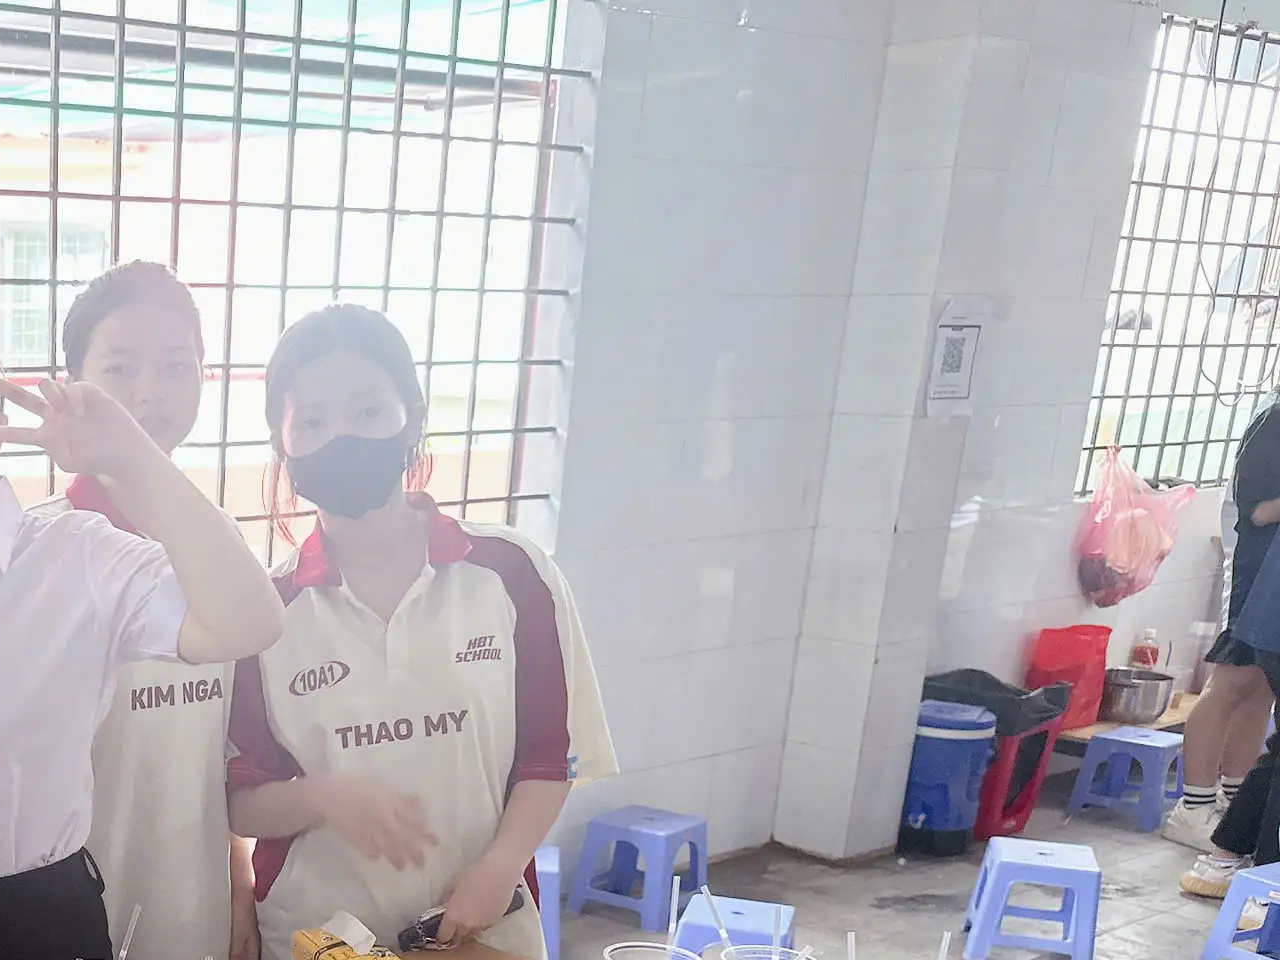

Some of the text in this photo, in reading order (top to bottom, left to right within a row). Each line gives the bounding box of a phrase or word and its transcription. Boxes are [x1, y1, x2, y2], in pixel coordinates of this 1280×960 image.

[455, 648, 502, 663] SCHOOL
[467, 635, 495, 650] HBT
[299, 664, 335, 692] 10A1
[131, 678, 223, 711] KIM NGA
[335, 710, 468, 749] THAO MY
